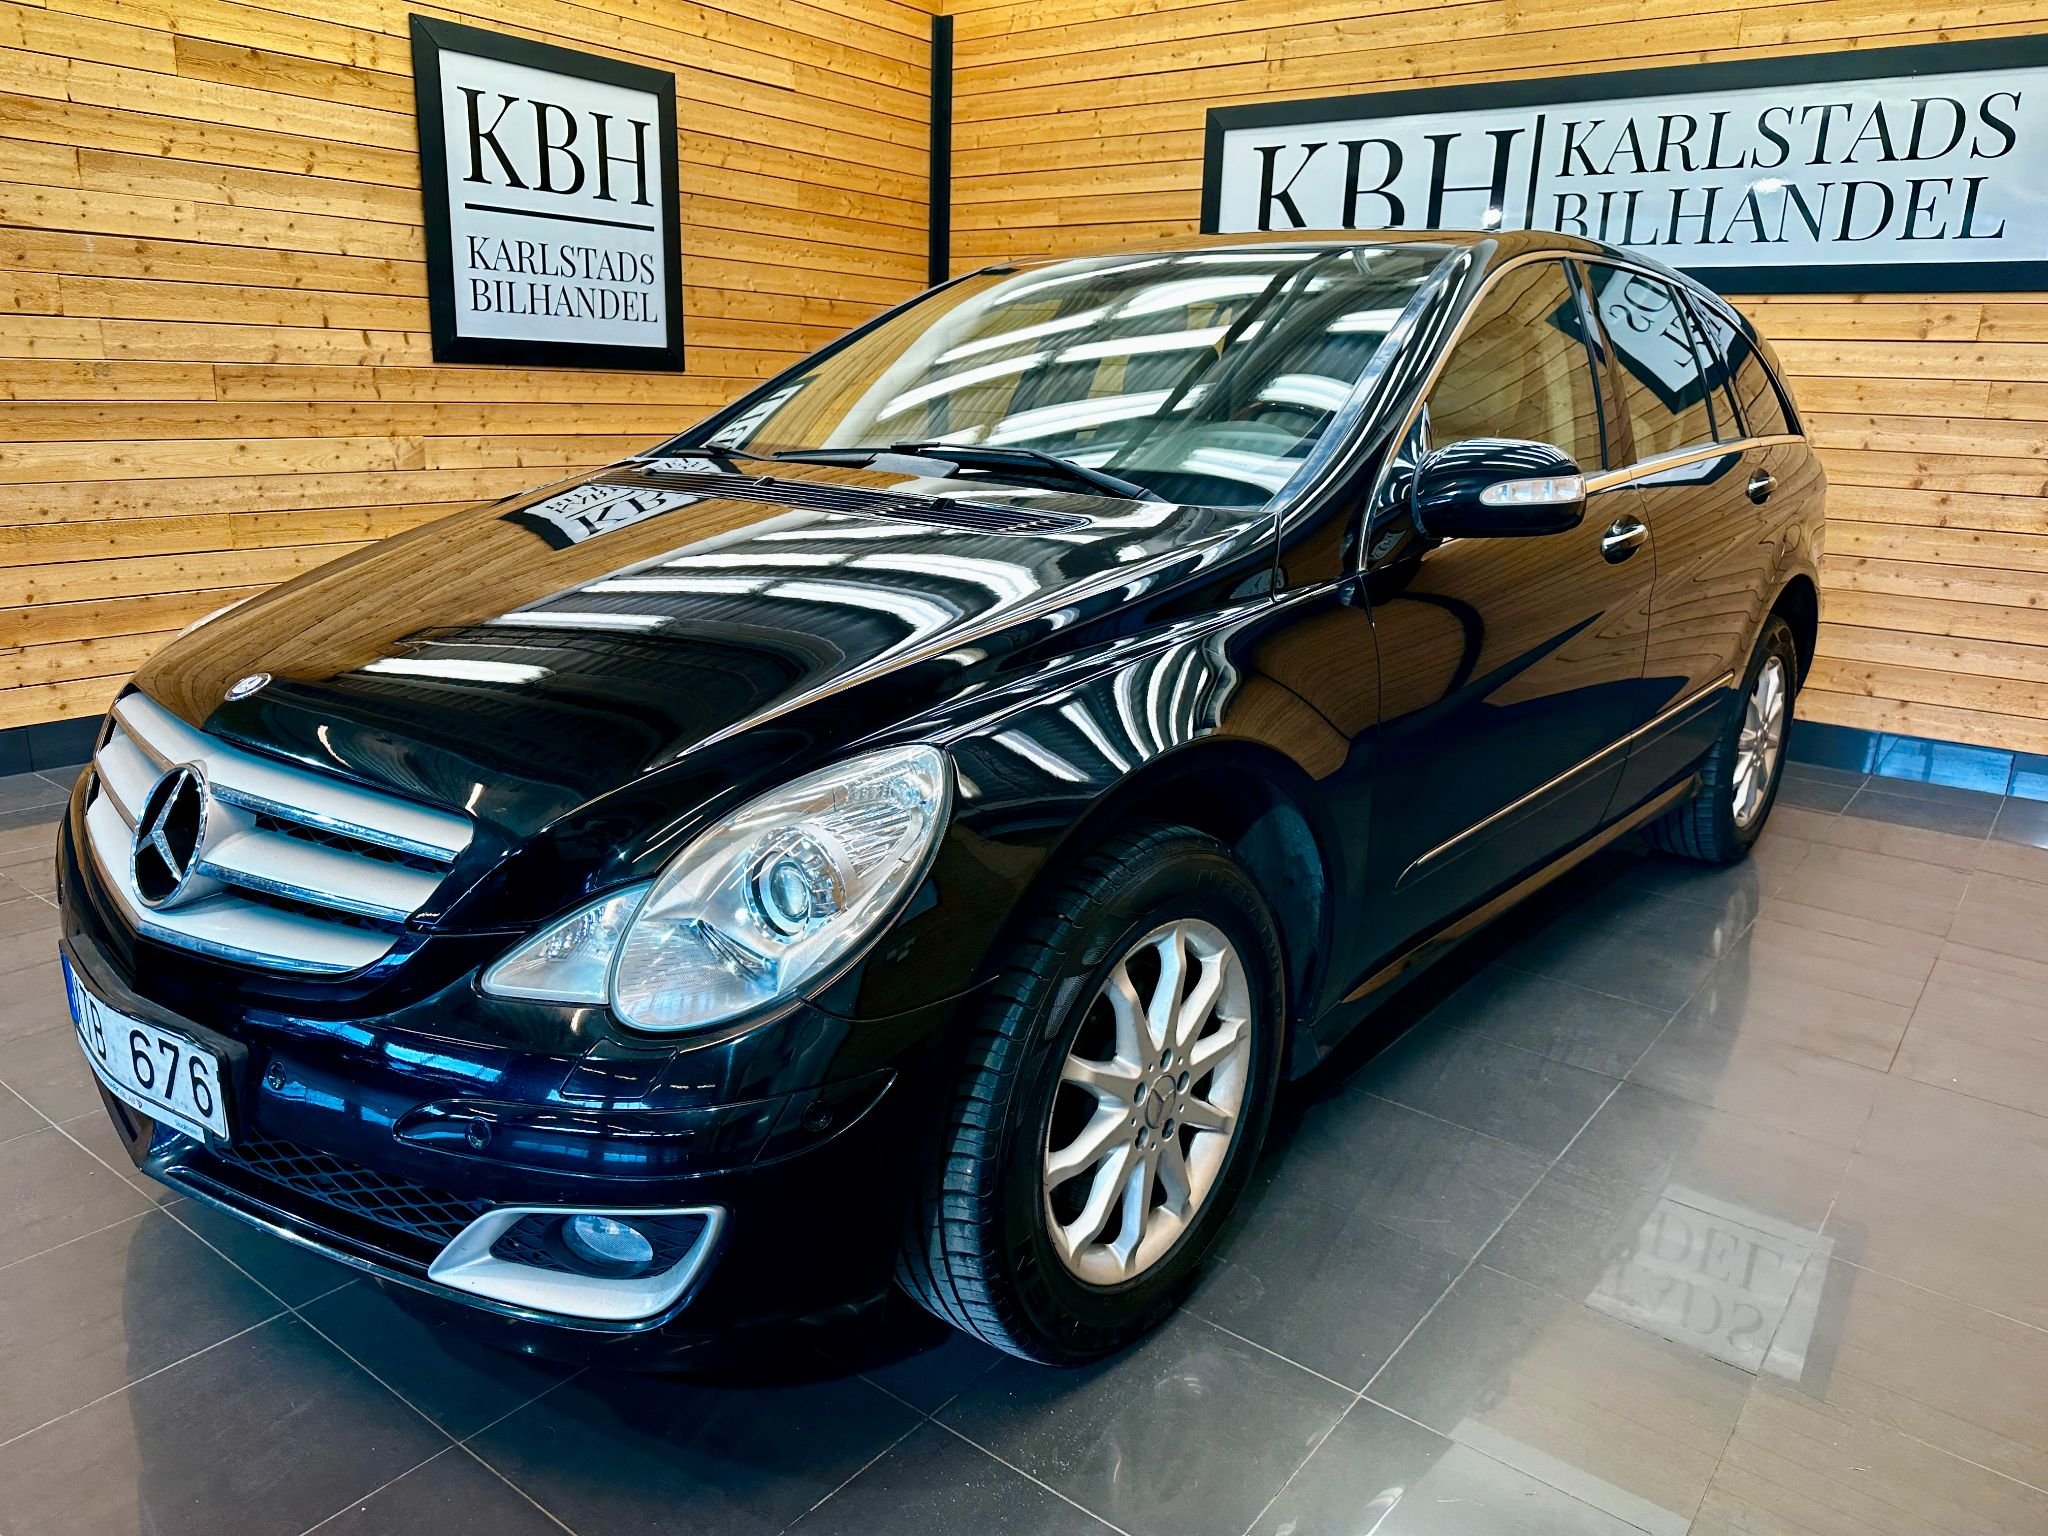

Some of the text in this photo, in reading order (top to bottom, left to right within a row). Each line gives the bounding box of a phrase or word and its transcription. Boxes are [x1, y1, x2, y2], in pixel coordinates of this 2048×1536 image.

[456, 86, 654, 207] KBH
[1555, 92, 2022, 177] KARLSTADS
[1253, 128, 1525, 230] KBH
[1553, 176, 2006, 245] BILHANDEL
[467, 235, 655, 285] KARLSTADS
[469, 278, 658, 323] BILHANDEL
[129, 1029, 213, 1118] 676
